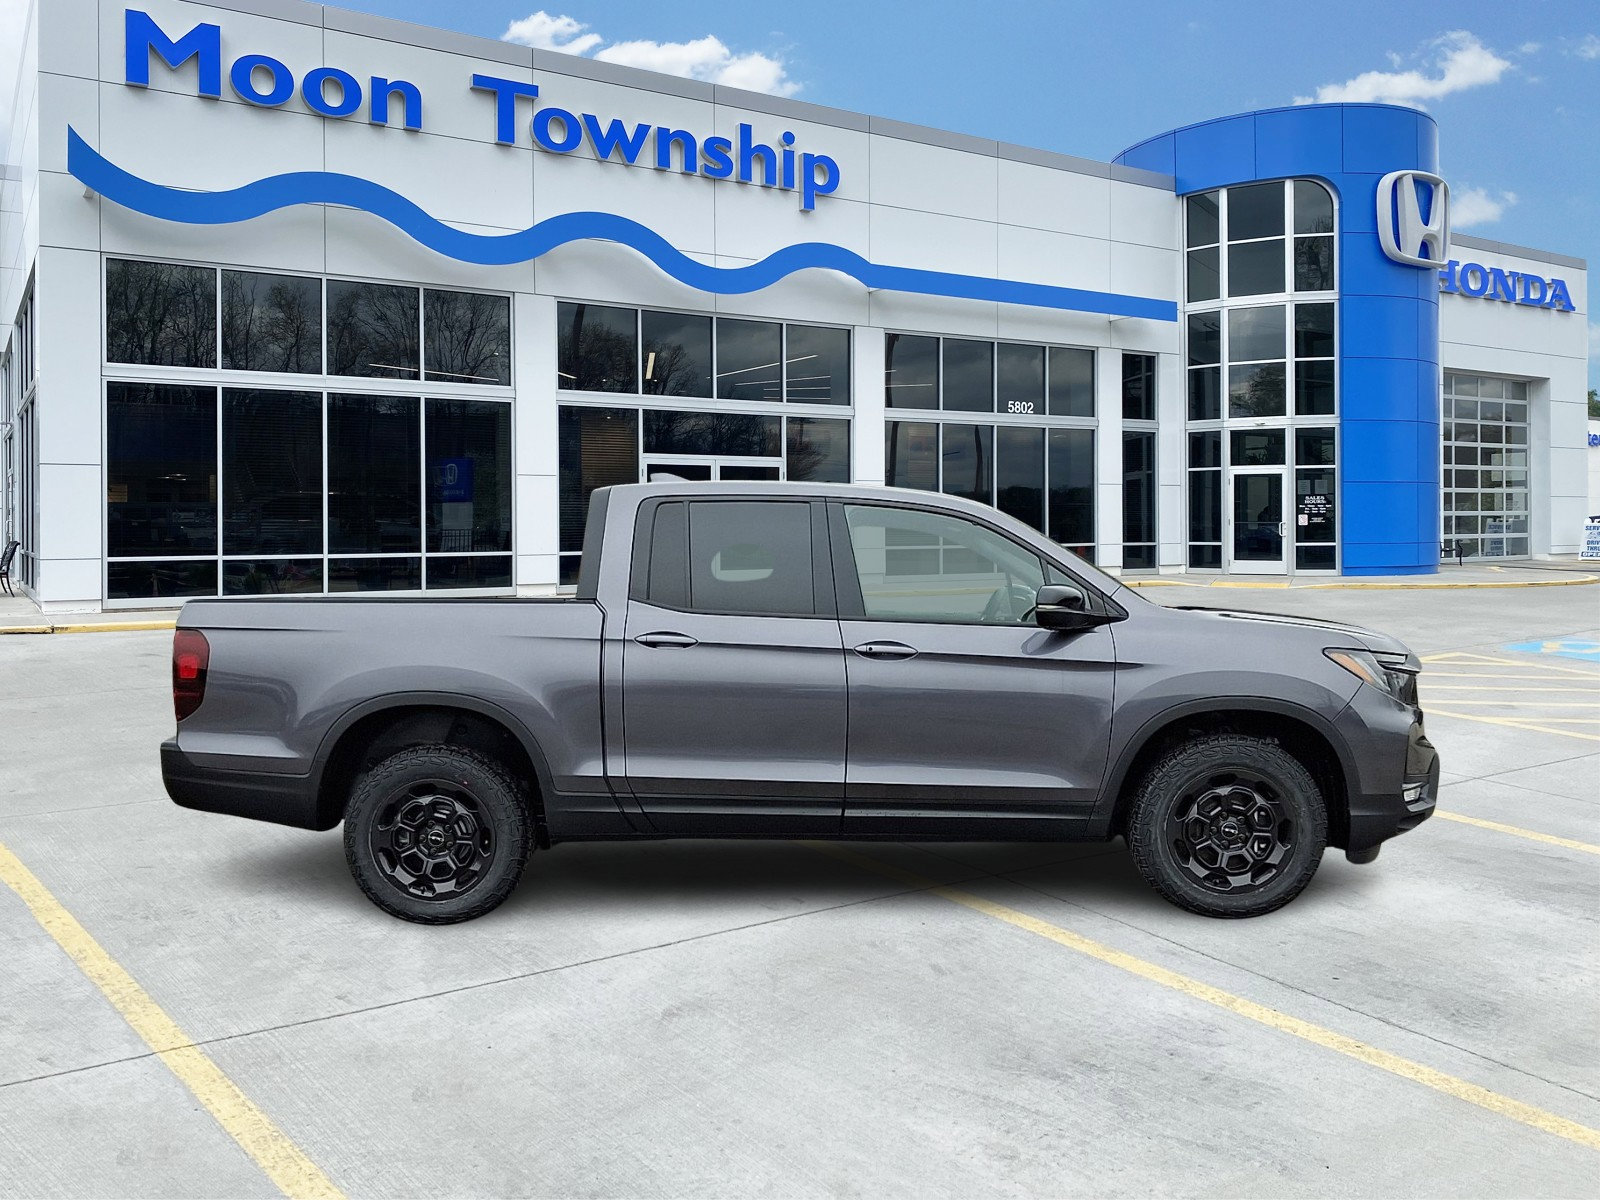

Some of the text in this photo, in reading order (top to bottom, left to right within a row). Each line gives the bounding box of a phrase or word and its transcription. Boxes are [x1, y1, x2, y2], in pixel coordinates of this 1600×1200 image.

[125, 9, 840, 212] Moon Township
[1438, 259, 1576, 312] HONDA
[1007, 400, 1034, 414] 5802
